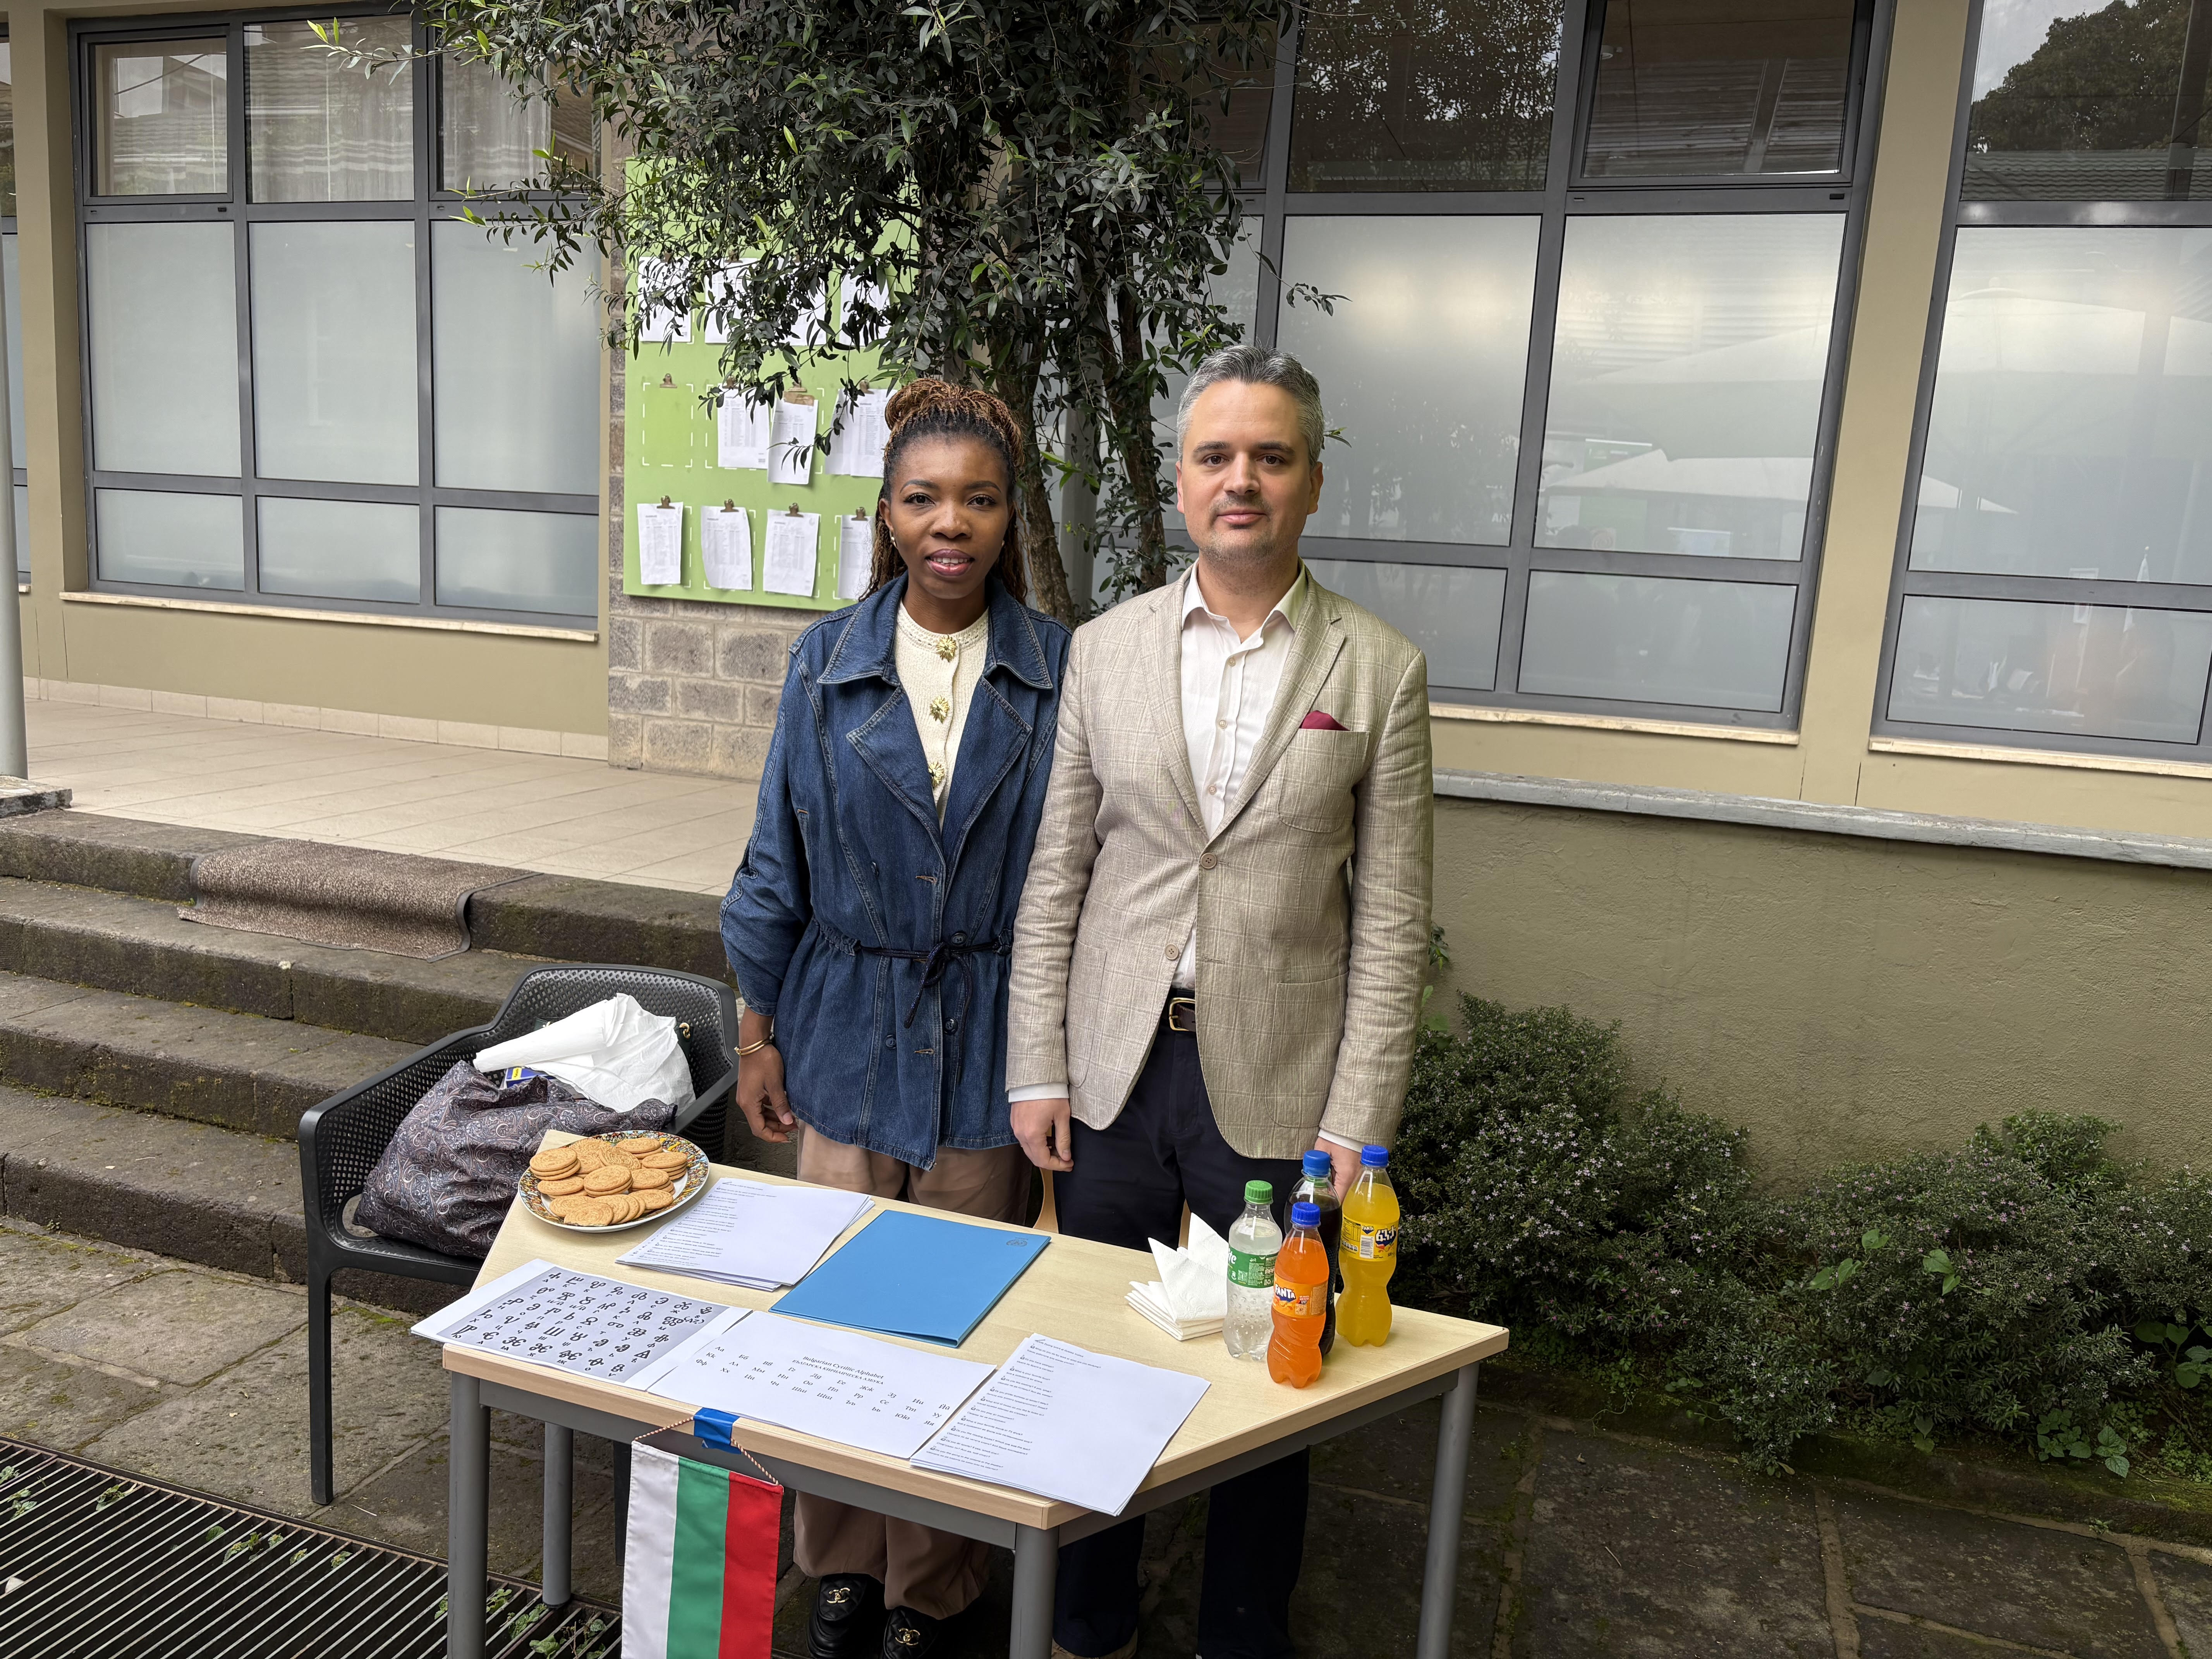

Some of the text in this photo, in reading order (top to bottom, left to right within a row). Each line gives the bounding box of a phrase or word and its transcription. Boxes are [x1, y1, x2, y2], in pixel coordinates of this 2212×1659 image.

[1275, 1283, 1296, 1298] FANTA
[792, 1360, 821, 1369] БЪЛГАРСКА
[802, 1356, 832, 1366] Bulgarian
[855, 1370, 884, 1379] Alphabet
